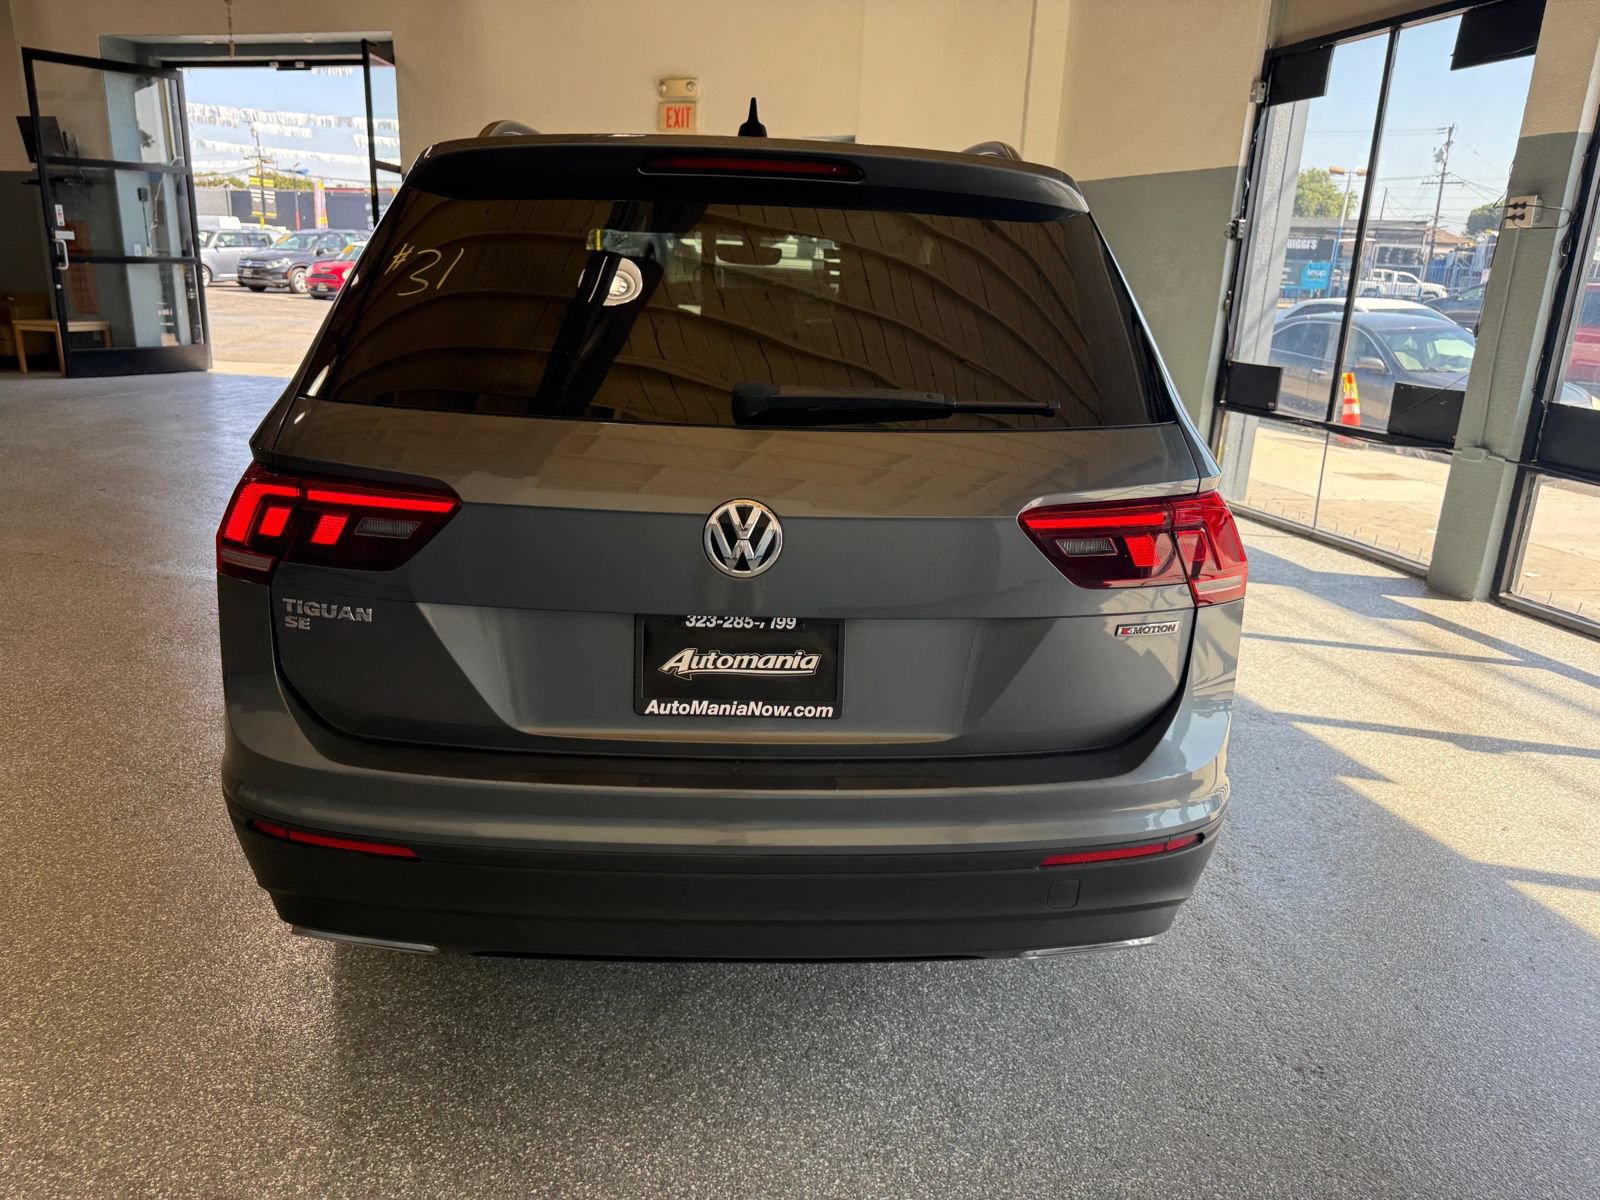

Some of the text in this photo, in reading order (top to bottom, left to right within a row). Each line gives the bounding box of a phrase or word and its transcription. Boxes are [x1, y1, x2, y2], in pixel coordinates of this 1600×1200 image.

[666, 107, 692, 129] EXIT
[384, 243, 464, 296] #31
[282, 598, 372, 622] TIGUAN
[285, 616, 310, 630] SE
[658, 648, 822, 679] Automania
[644, 699, 834, 718] AutoManiaNow.com
